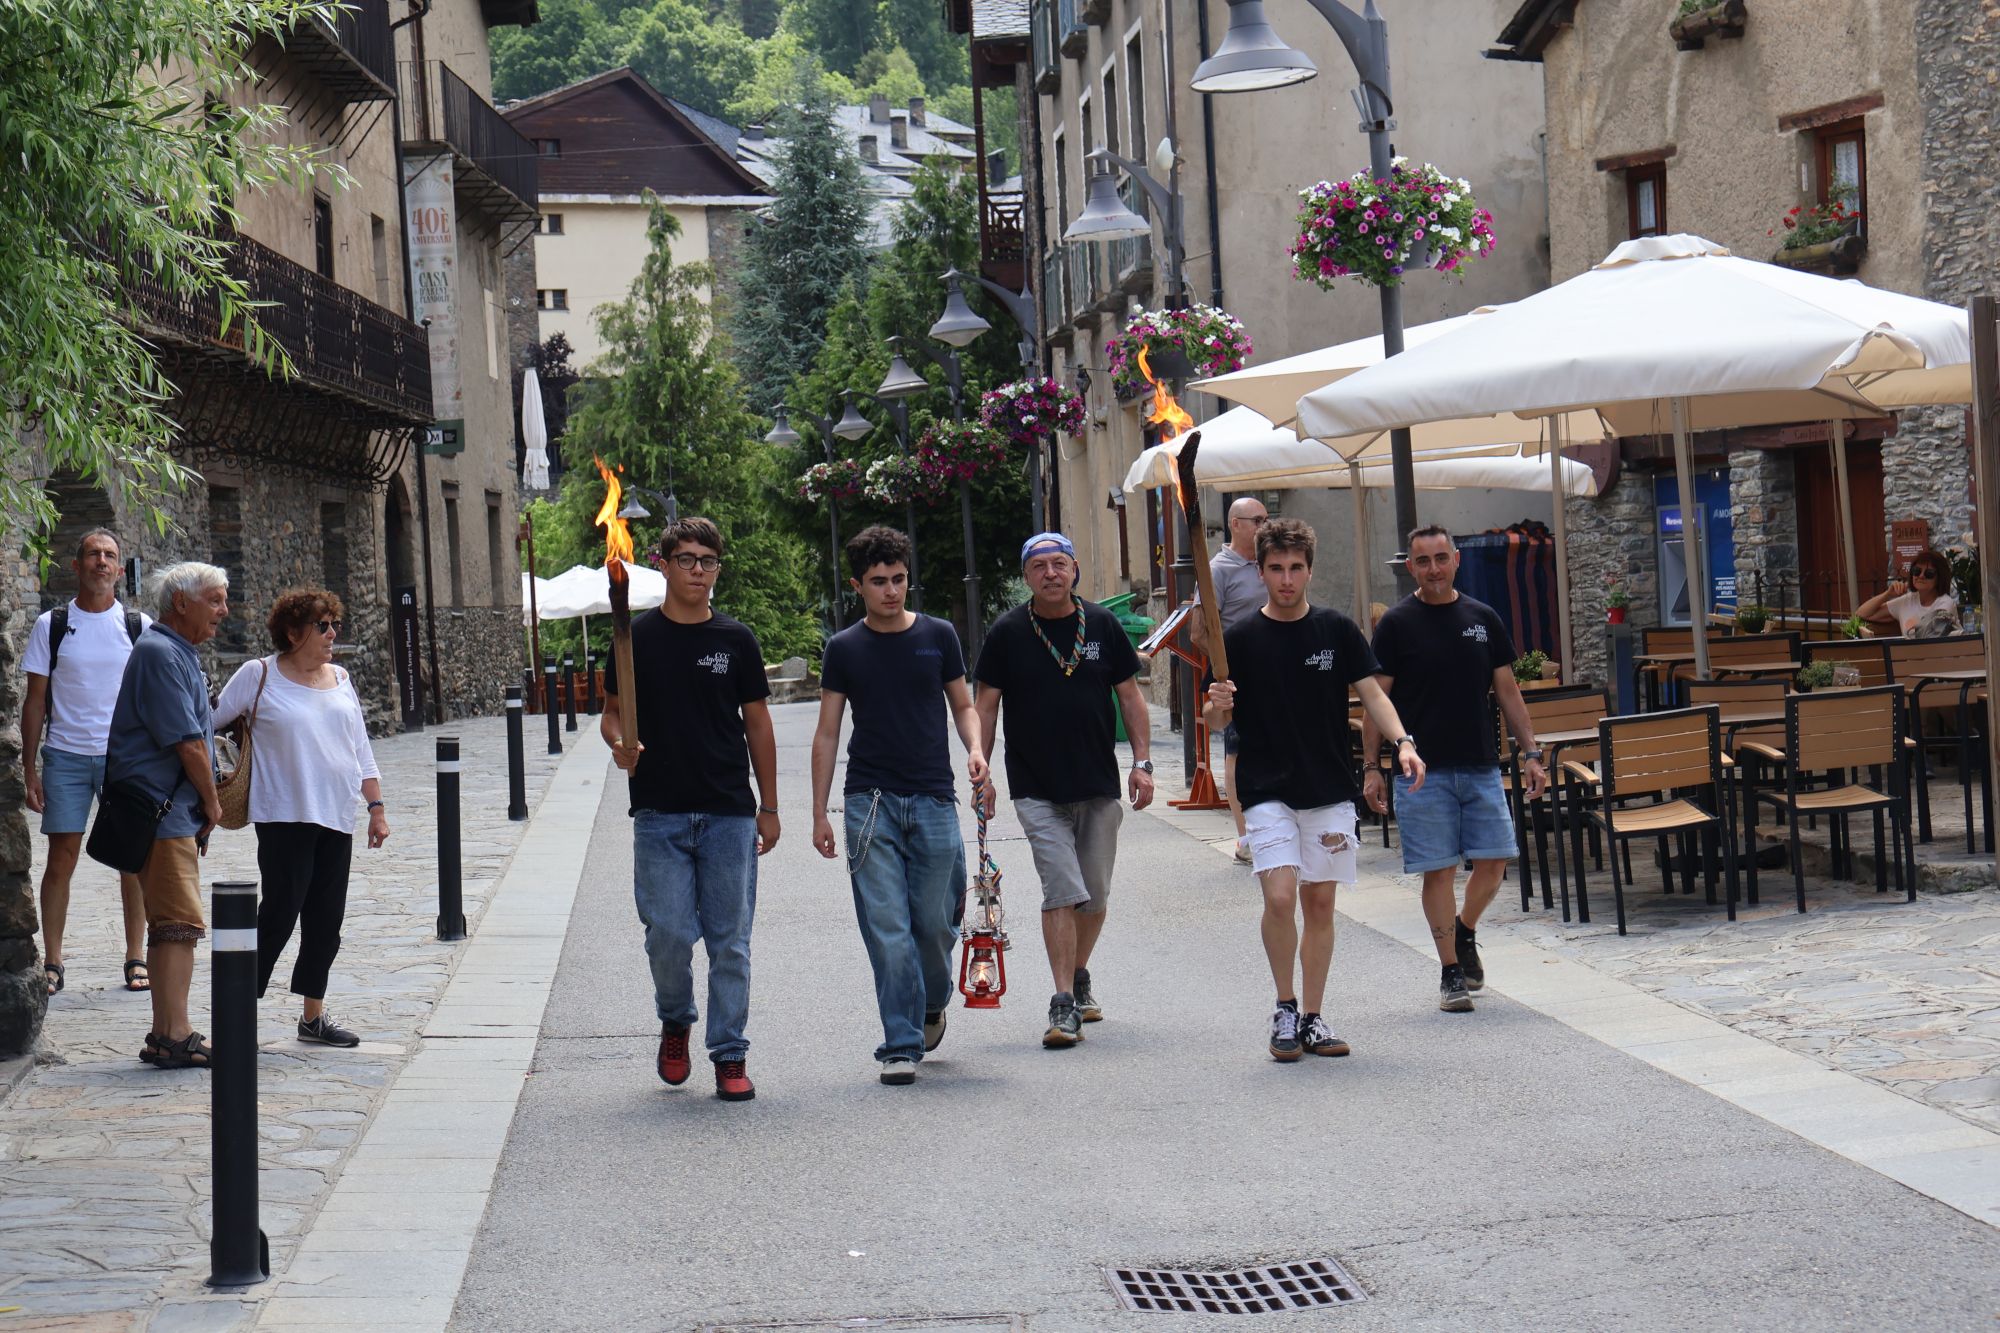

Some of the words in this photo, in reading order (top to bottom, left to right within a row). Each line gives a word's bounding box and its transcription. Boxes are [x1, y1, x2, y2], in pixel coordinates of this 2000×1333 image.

[411, 207, 449, 234] 40È
[419, 271, 448, 287] CASA
[714, 651, 730, 660] CCC
[697, 658, 712, 666] Sant
